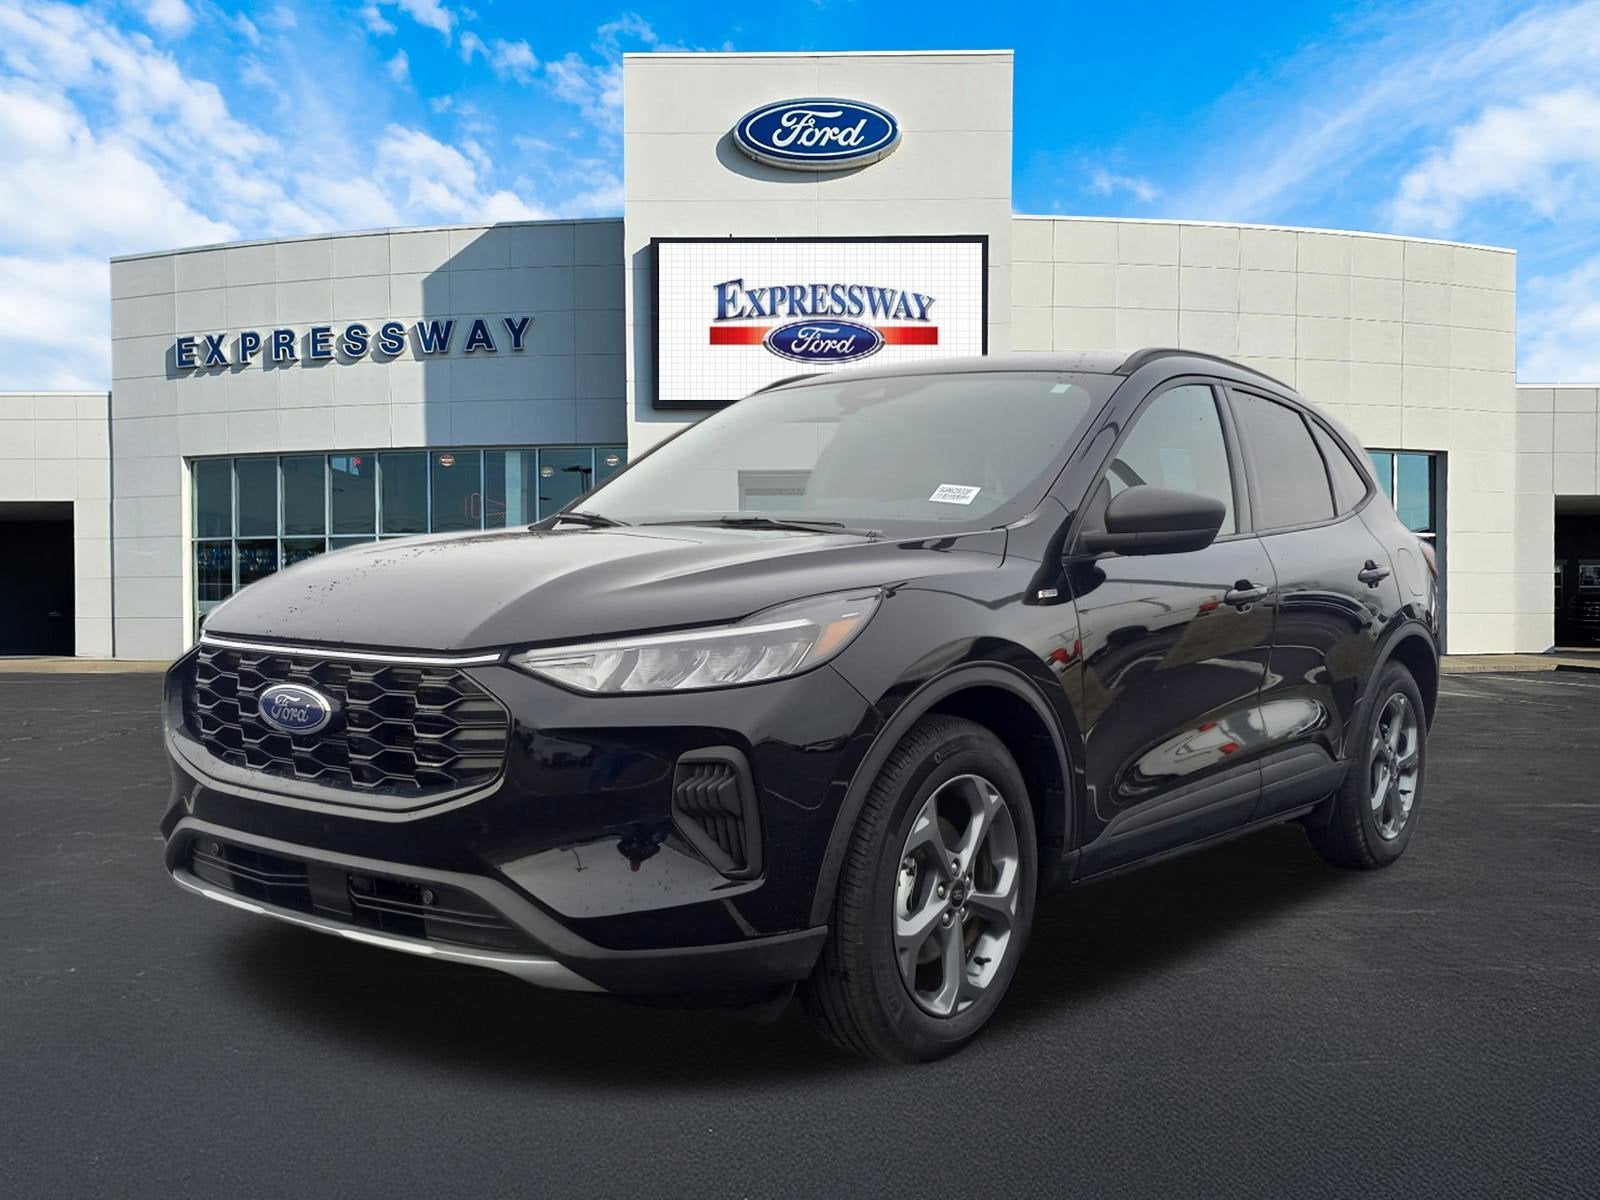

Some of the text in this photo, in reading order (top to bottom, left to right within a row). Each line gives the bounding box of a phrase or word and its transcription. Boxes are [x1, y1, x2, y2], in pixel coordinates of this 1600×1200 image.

[772, 109, 868, 148] Ford
[175, 315, 533, 369] EXPRESSWAY
[791, 326, 856, 354] Ford
[270, 693, 310, 723] Ford
